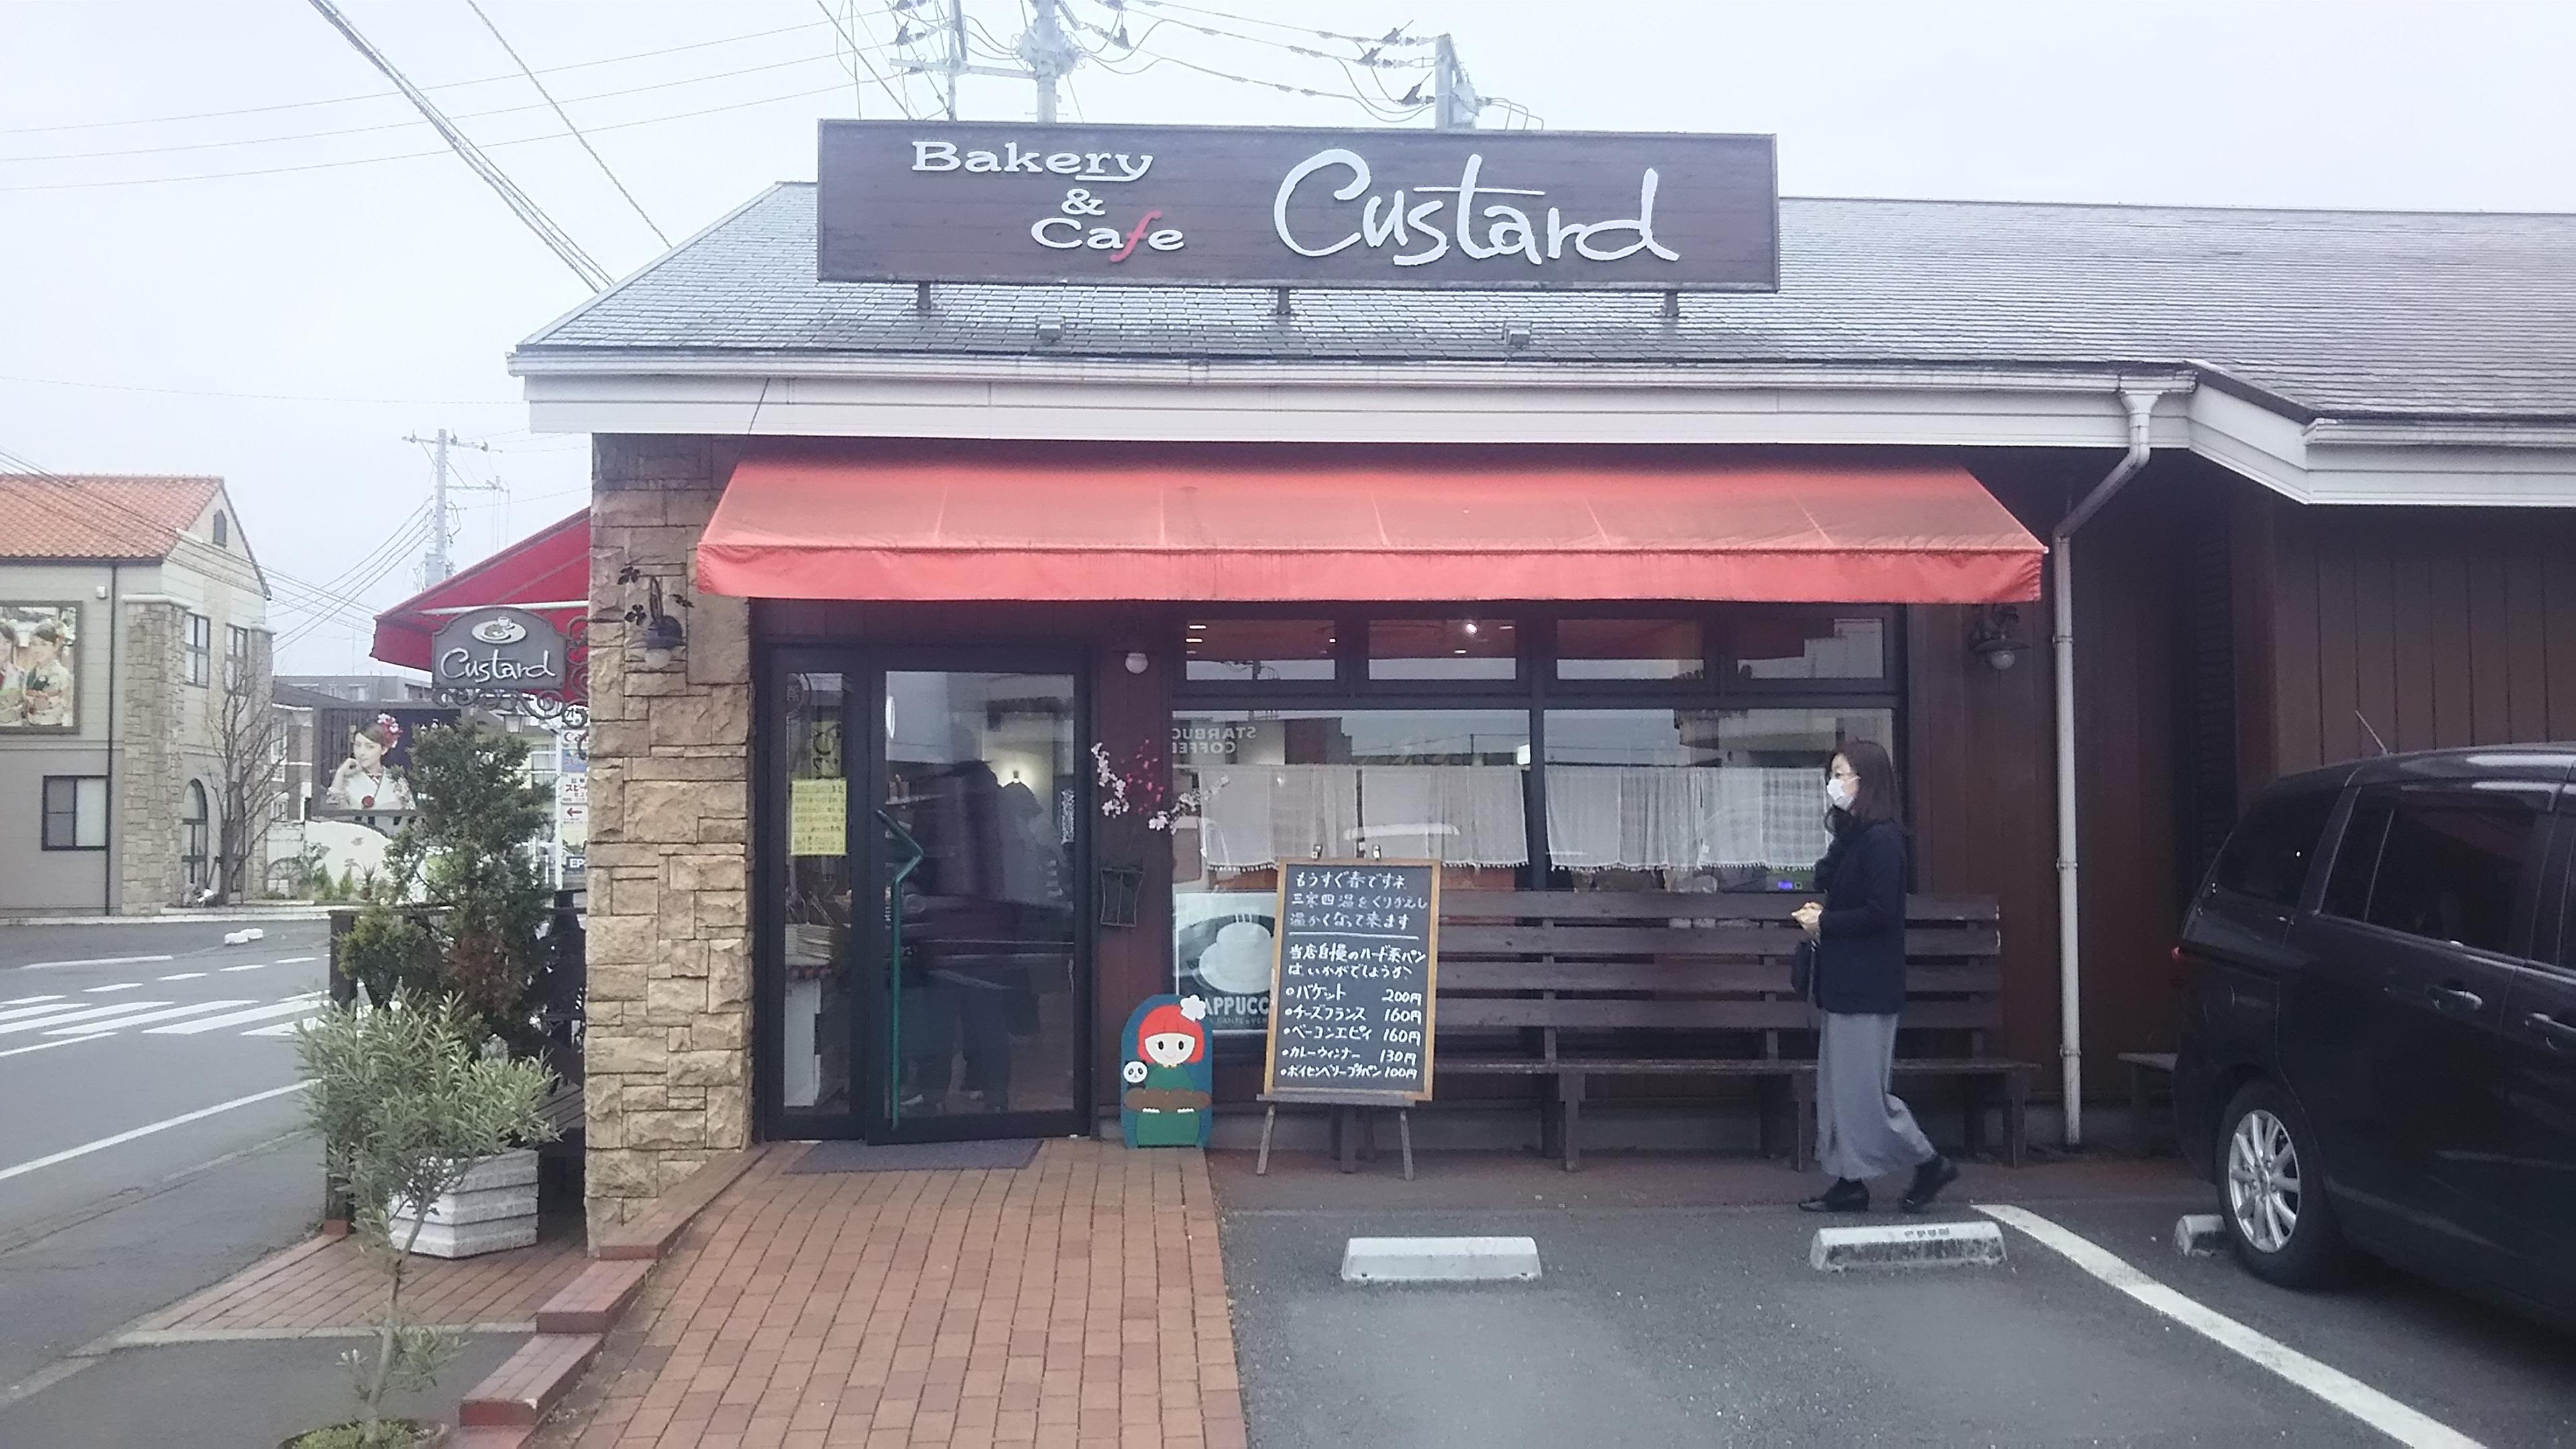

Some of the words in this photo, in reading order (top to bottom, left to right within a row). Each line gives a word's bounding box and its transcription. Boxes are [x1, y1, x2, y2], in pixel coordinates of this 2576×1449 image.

[912, 141, 1153, 182] Bakery
[1061, 188, 1106, 215] &
[1275, 148, 1680, 266] Custard
[1031, 210, 1185, 263] Cafe
[440, 647, 556, 683] Custard
[1381, 989, 1422, 1006] 200円
[1384, 1008, 1421, 1025] 160円
[1383, 1028, 1421, 1046] 160円
[1380, 1049, 1417, 1066] 130円
[1385, 1066, 1417, 1080] 100円
